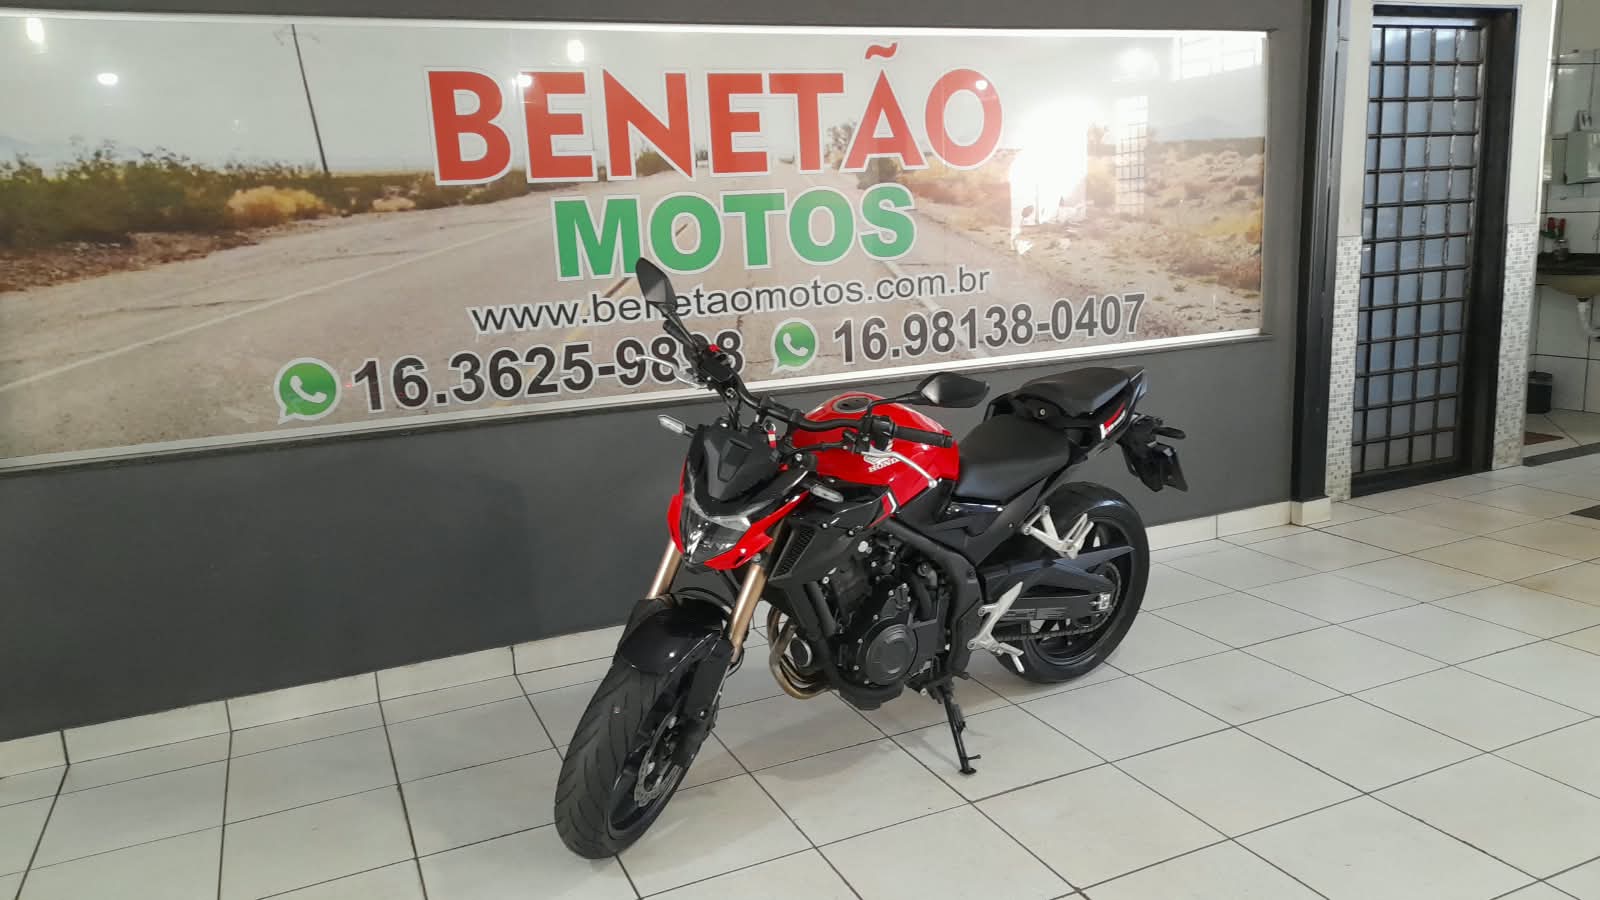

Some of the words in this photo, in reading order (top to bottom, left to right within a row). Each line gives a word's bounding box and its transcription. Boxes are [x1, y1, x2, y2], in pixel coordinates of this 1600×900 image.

[427, 41, 1004, 184] BENETÃO
[552, 184, 917, 280] MOTOS
[834, 293, 1145, 363] 16.98138-0407
